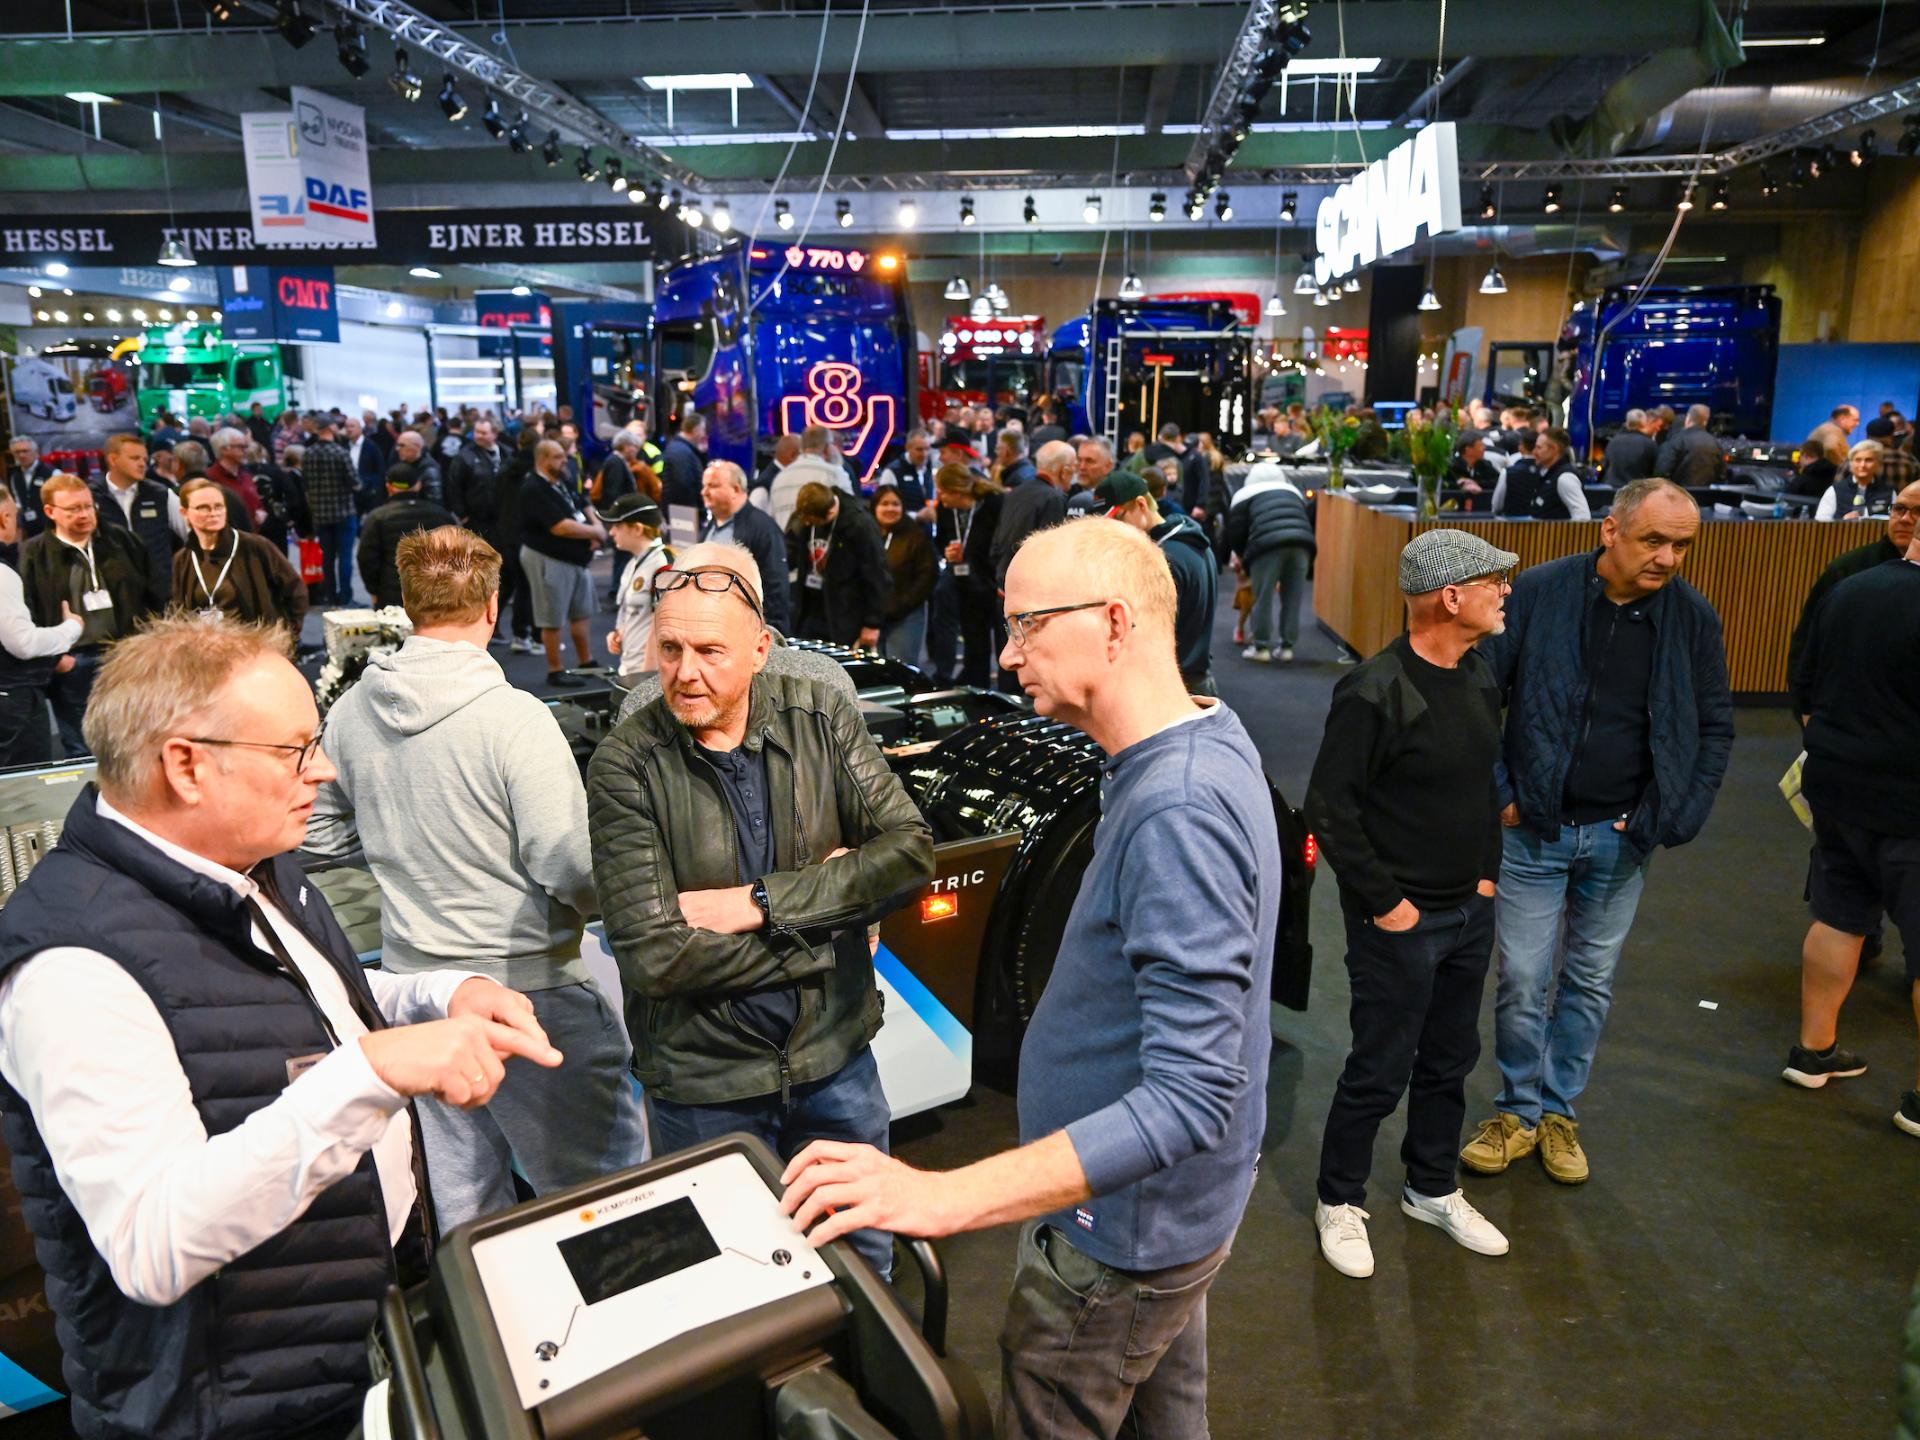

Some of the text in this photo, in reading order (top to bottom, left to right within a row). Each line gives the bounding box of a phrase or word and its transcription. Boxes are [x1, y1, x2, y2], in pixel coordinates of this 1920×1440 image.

[305, 176, 368, 209] DAF
[1315, 121, 1450, 286] SCANIA
[3, 228, 113, 252] HESSEL
[428, 221, 651, 251] EJNER HESSEL
[807, 248, 844, 270] 770
[278, 275, 330, 310] CMT
[930, 869, 985, 893] TRIC
[597, 1190, 655, 1214] KEMPOWER
